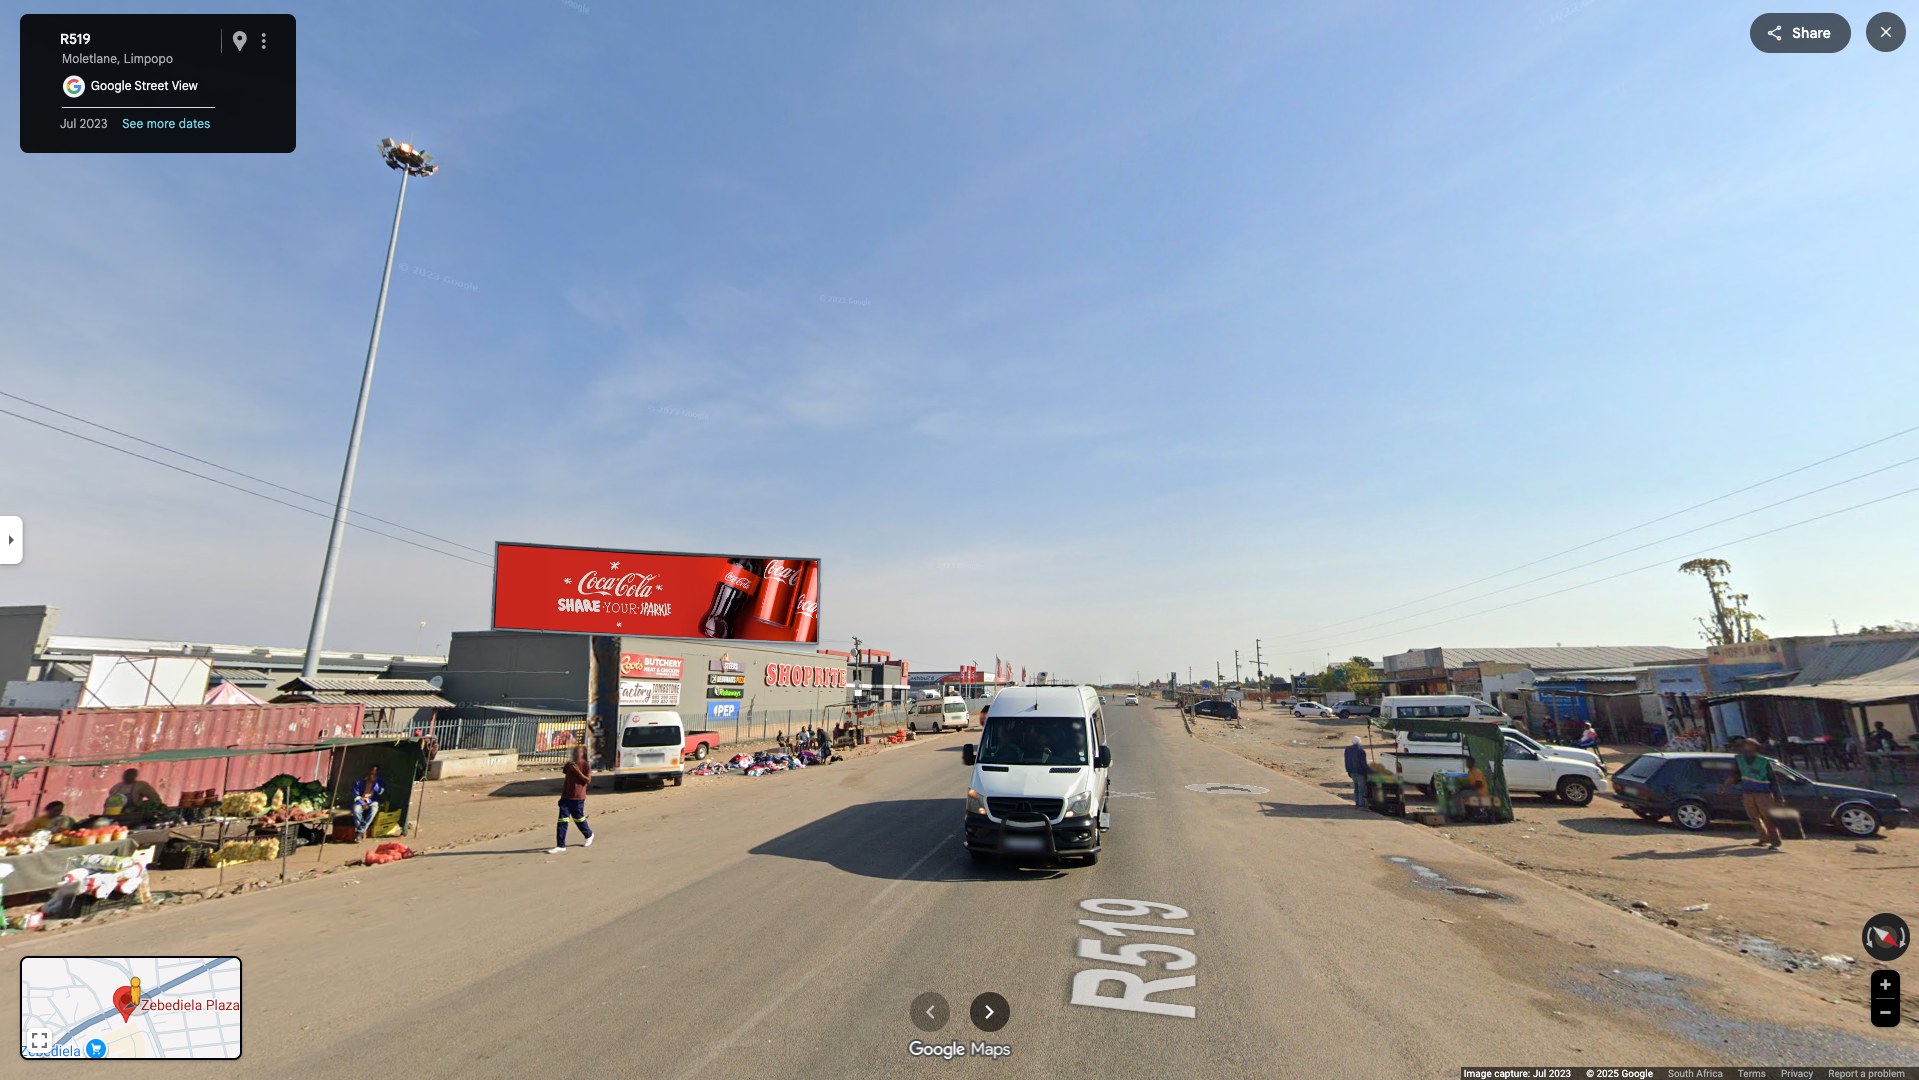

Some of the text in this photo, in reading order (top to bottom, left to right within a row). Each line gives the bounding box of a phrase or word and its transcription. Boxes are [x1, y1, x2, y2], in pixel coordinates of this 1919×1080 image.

[557, 598, 672, 616] SHARE YOUR SPARKLE
[644, 657, 682, 668] BUTCHERY
[765, 662, 847, 688] SHOPRITE
[652, 683, 680, 694] TOMBSTONE
[717, 704, 735, 717] PEP
